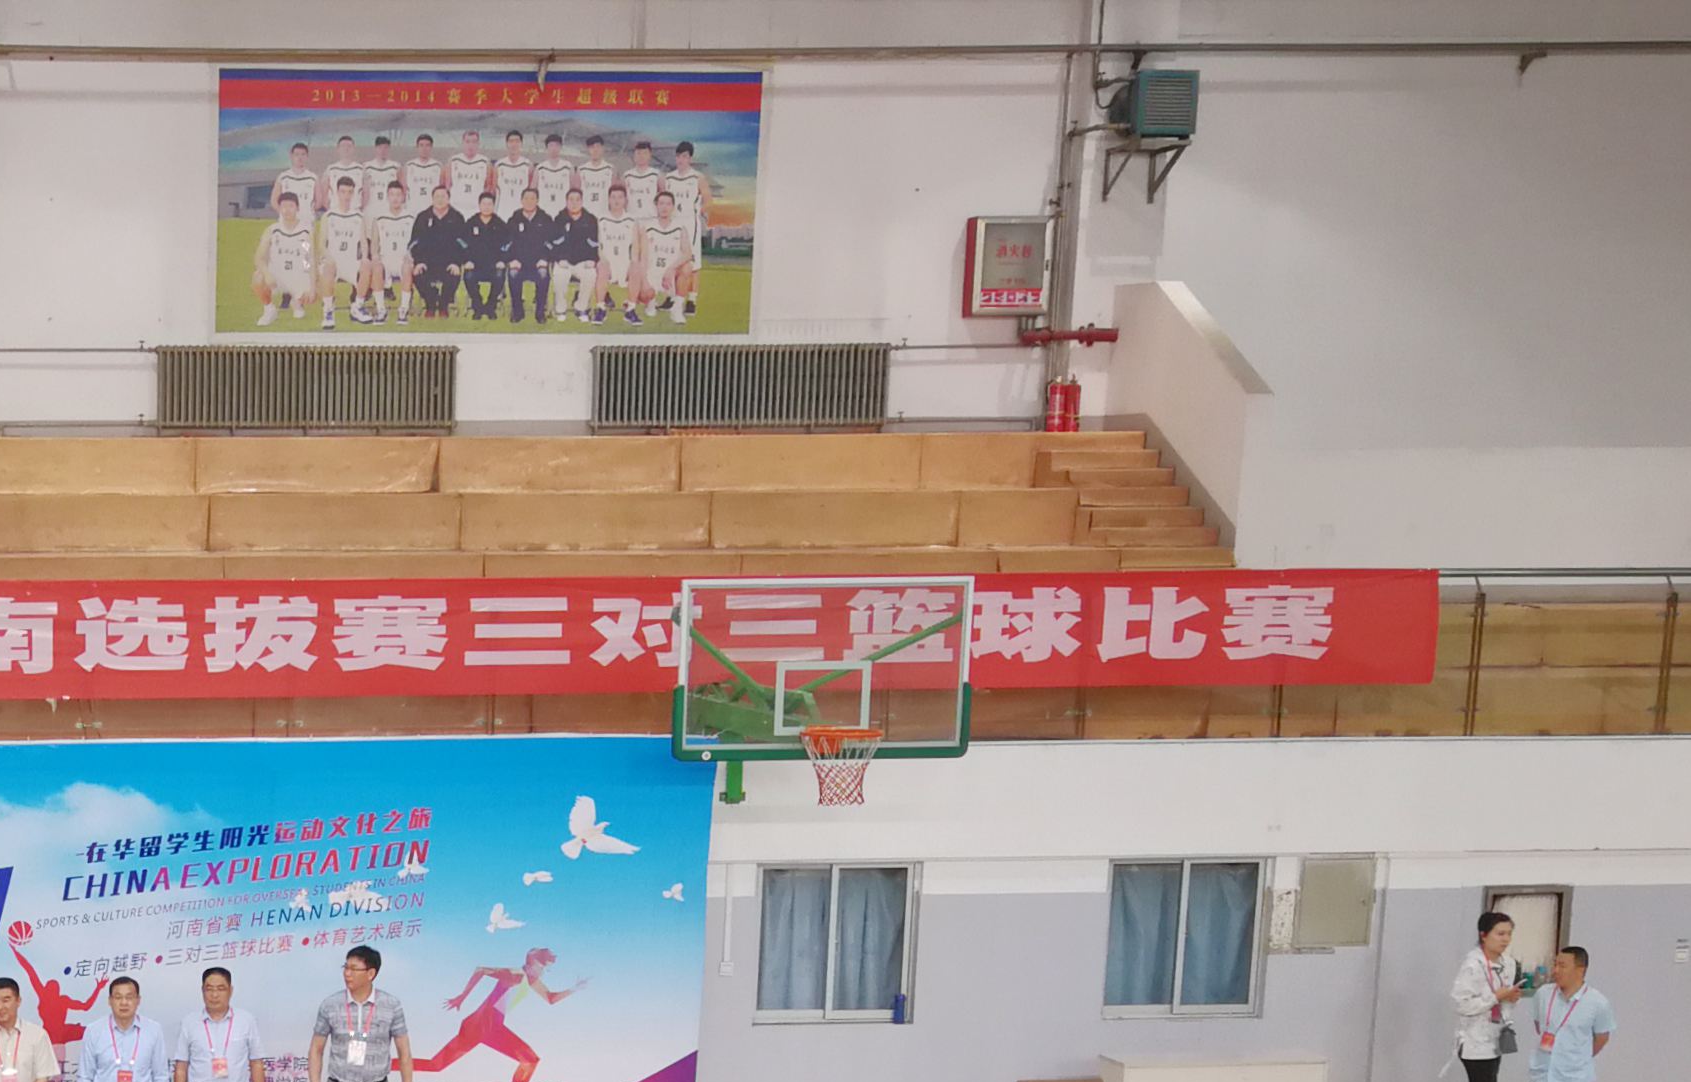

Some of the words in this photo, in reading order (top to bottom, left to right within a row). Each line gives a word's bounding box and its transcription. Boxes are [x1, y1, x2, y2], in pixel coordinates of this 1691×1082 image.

[61, 866, 170, 902] CHINA
[179, 839, 431, 889] EXPLORATION
[35, 914, 79, 930] SPORTS
[81, 914, 90, 924] &
[93, 907, 143, 922] CULTURE
[146, 897, 224, 916] COMPETITION
[166, 912, 243, 940] 河南省赛
[250, 904, 322, 928] HENAN
[328, 892, 426, 917] DIVISION
[74, 951, 148, 978] 定向越野
[165, 933, 293, 965] 三对三篮球比赛
[312, 918, 423, 948] 体育艺术展示
